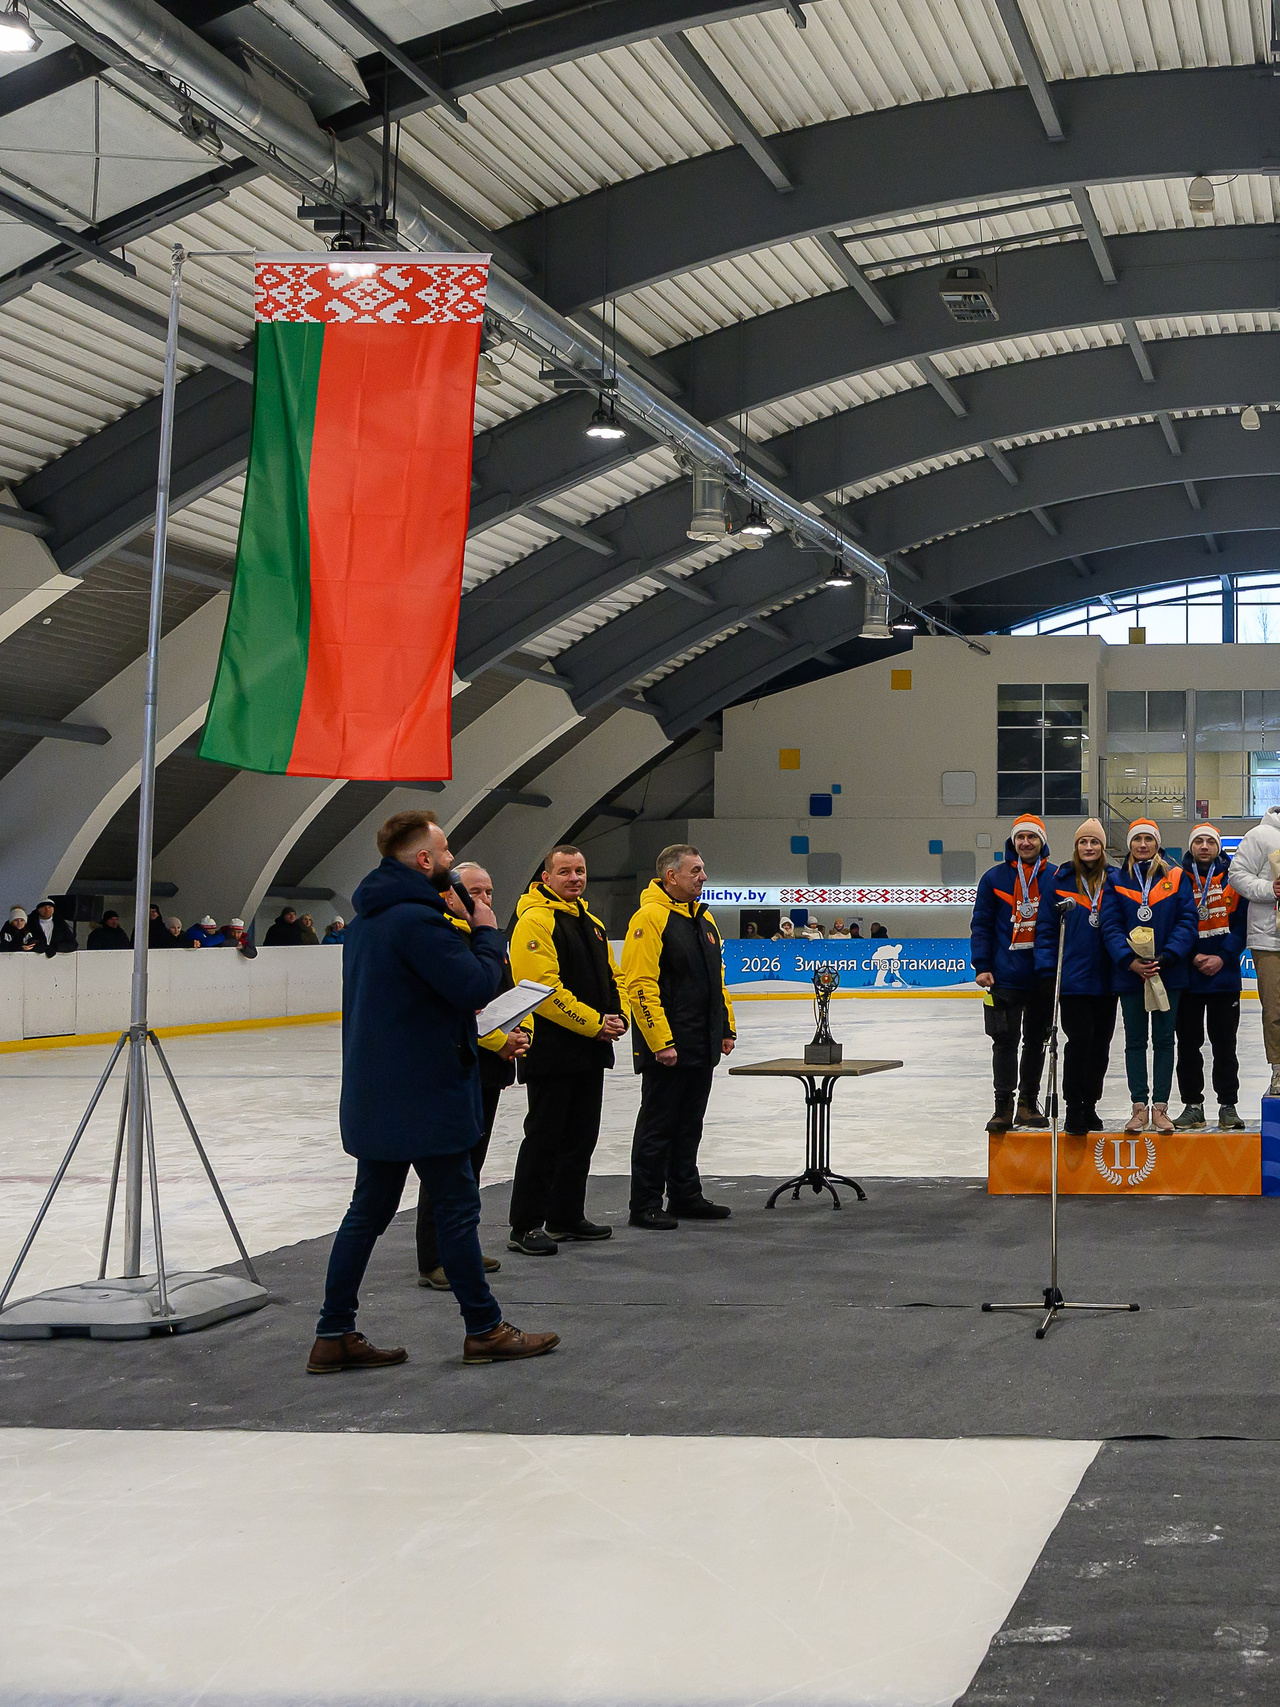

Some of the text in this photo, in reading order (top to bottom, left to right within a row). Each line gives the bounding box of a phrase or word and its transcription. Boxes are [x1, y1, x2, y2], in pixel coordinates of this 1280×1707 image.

[741, 957, 781, 972] 2026
[861, 958, 966, 974] спартакиада
[553, 998, 587, 1026] BELARUS
[637, 989, 655, 1029] BELARUS
[1110, 1140, 1140, 1169] II
